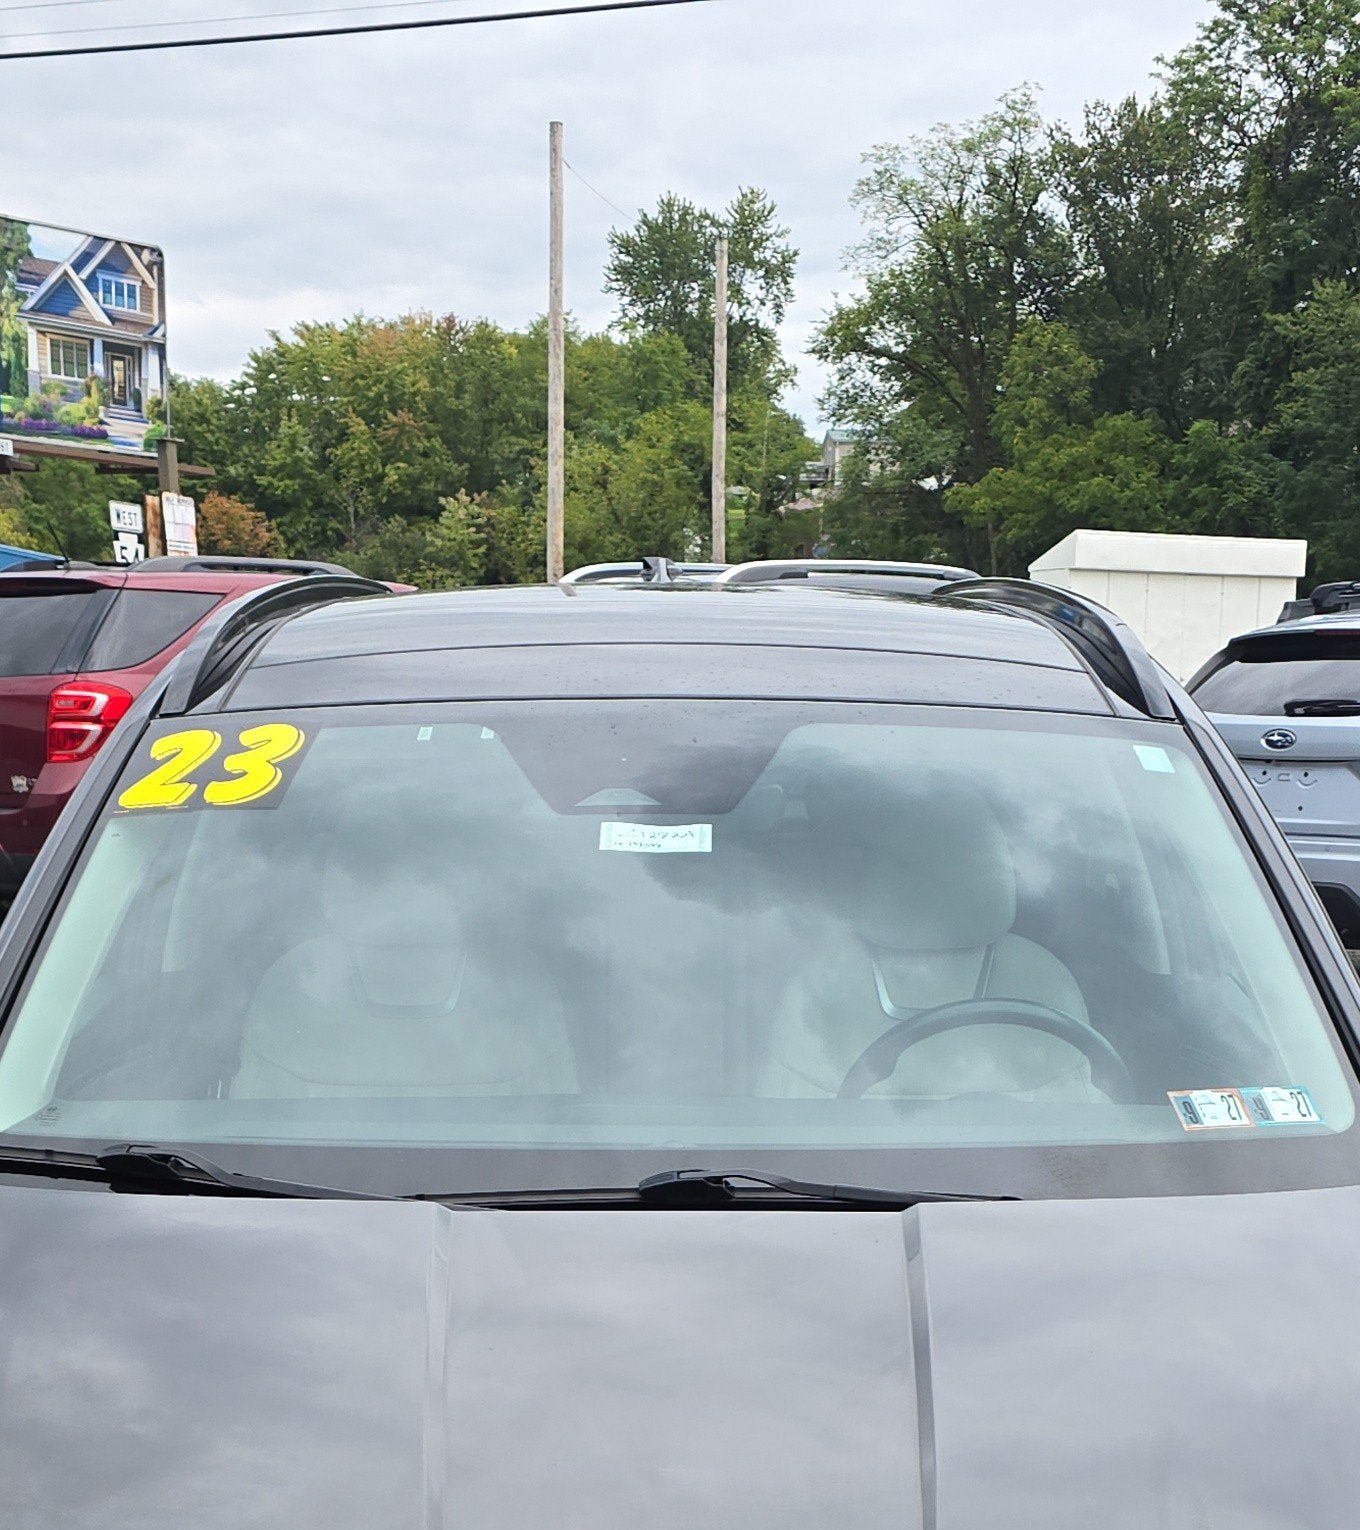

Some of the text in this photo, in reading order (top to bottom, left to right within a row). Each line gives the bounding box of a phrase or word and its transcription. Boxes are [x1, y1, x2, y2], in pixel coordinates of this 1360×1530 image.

[115, 507, 137, 526] WEST
[118, 723, 305, 809] 23
[1220, 1094, 1243, 1121] 27
[1289, 1091, 1312, 1118] 27
